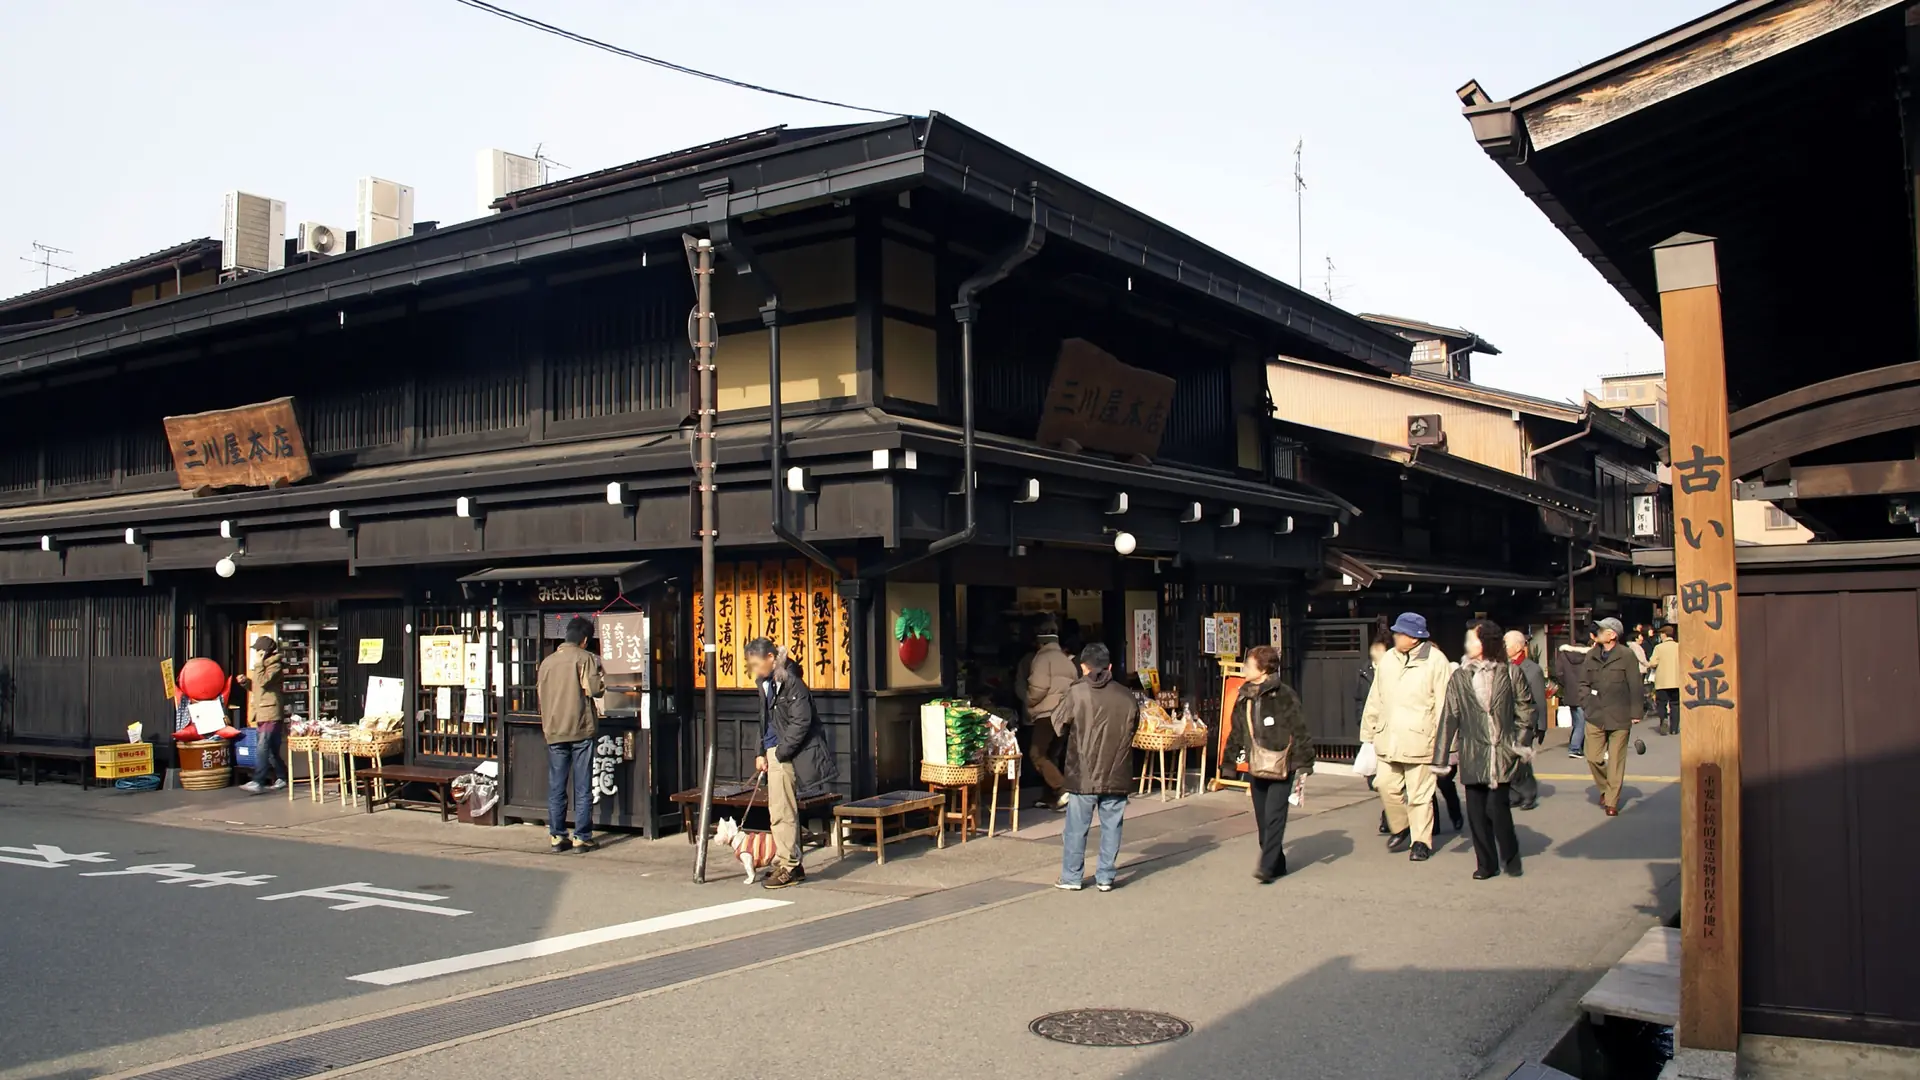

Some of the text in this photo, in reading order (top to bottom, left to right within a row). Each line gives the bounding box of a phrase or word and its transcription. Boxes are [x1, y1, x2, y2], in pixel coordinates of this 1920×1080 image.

[183, 424, 294, 469] 三川屋本店
[1053, 379, 1167, 433] 三川屋本店
[1674, 445, 1735, 710] 古い町並
[719, 594, 734, 676] お漬物
[813, 592, 831, 675] 駄菓子
